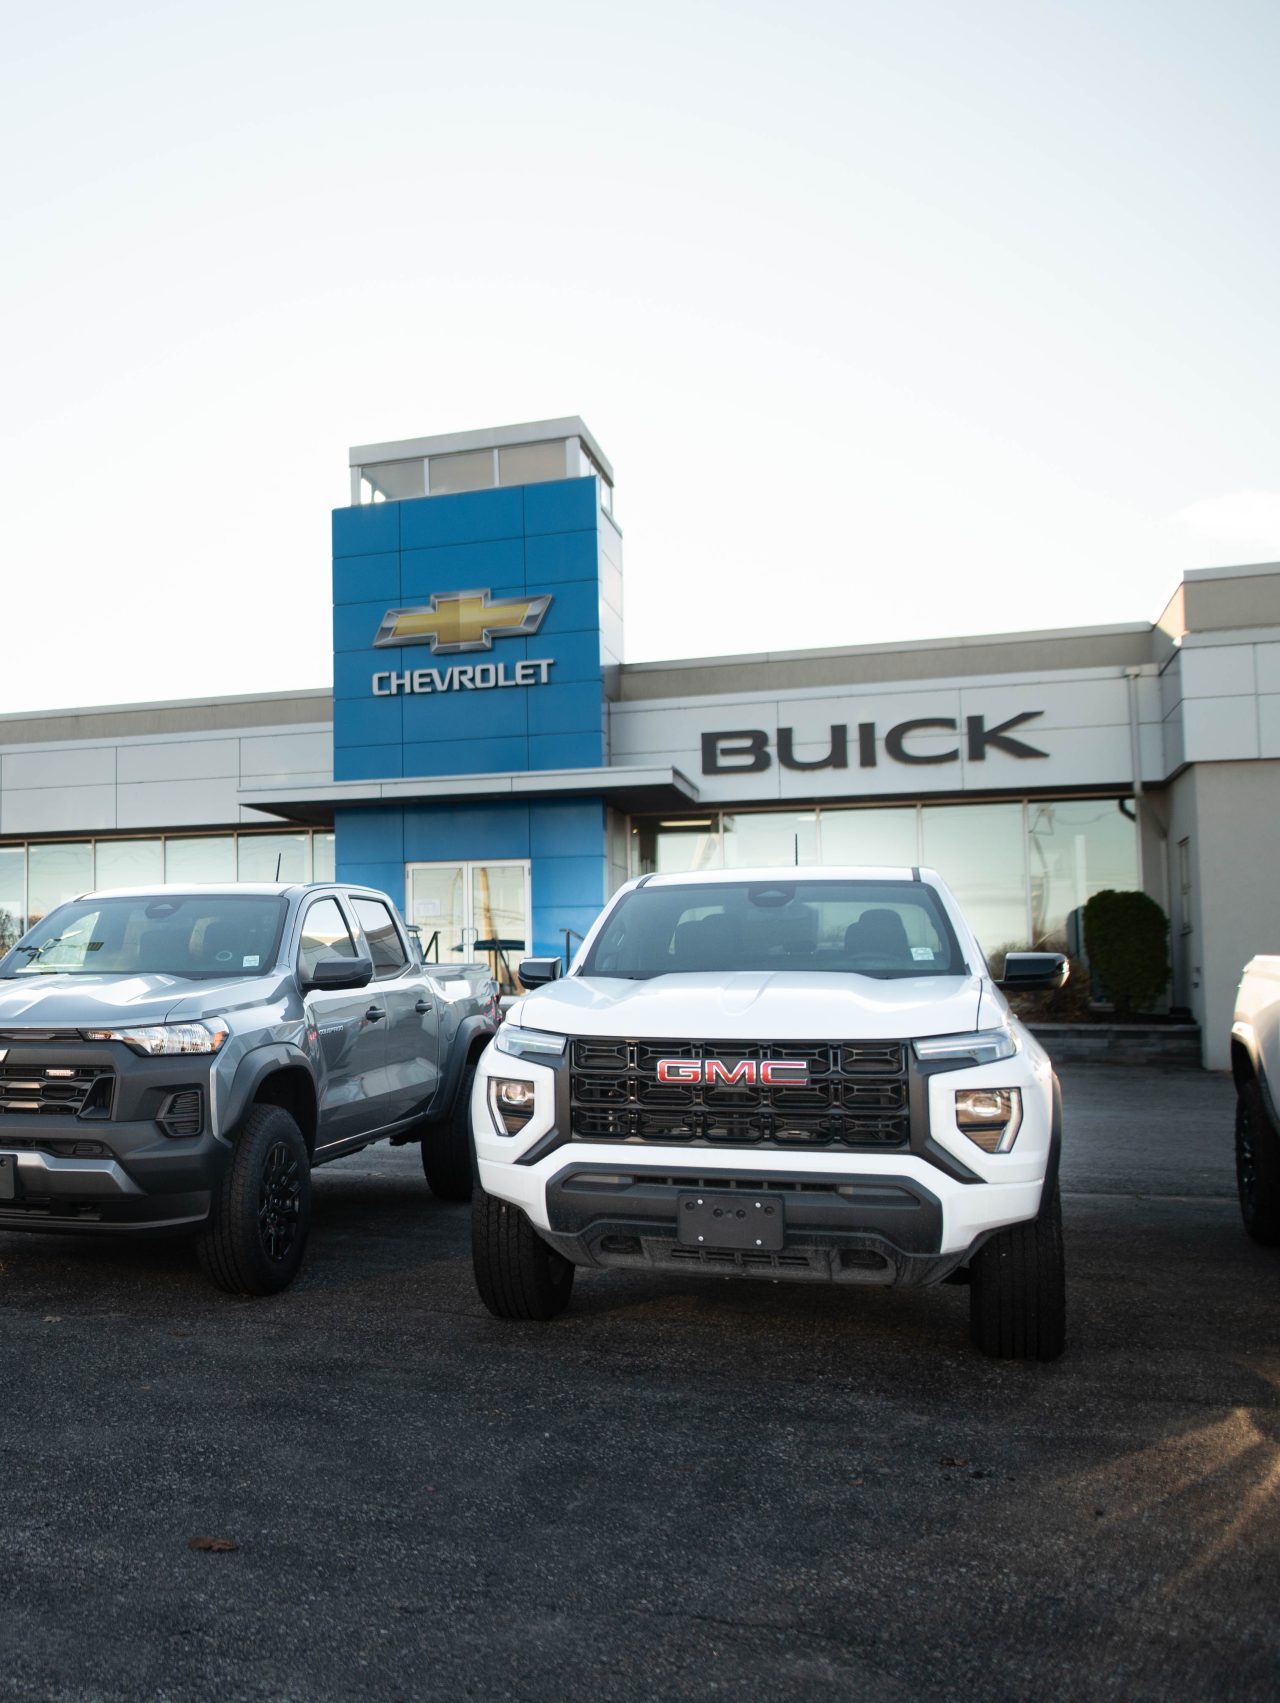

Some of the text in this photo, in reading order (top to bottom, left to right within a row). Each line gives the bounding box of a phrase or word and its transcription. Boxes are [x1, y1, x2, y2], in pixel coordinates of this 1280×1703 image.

[372, 659, 555, 697] CHEVROLET
[701, 711, 1050, 775] BUICK
[657, 1059, 808, 1085] GMC
